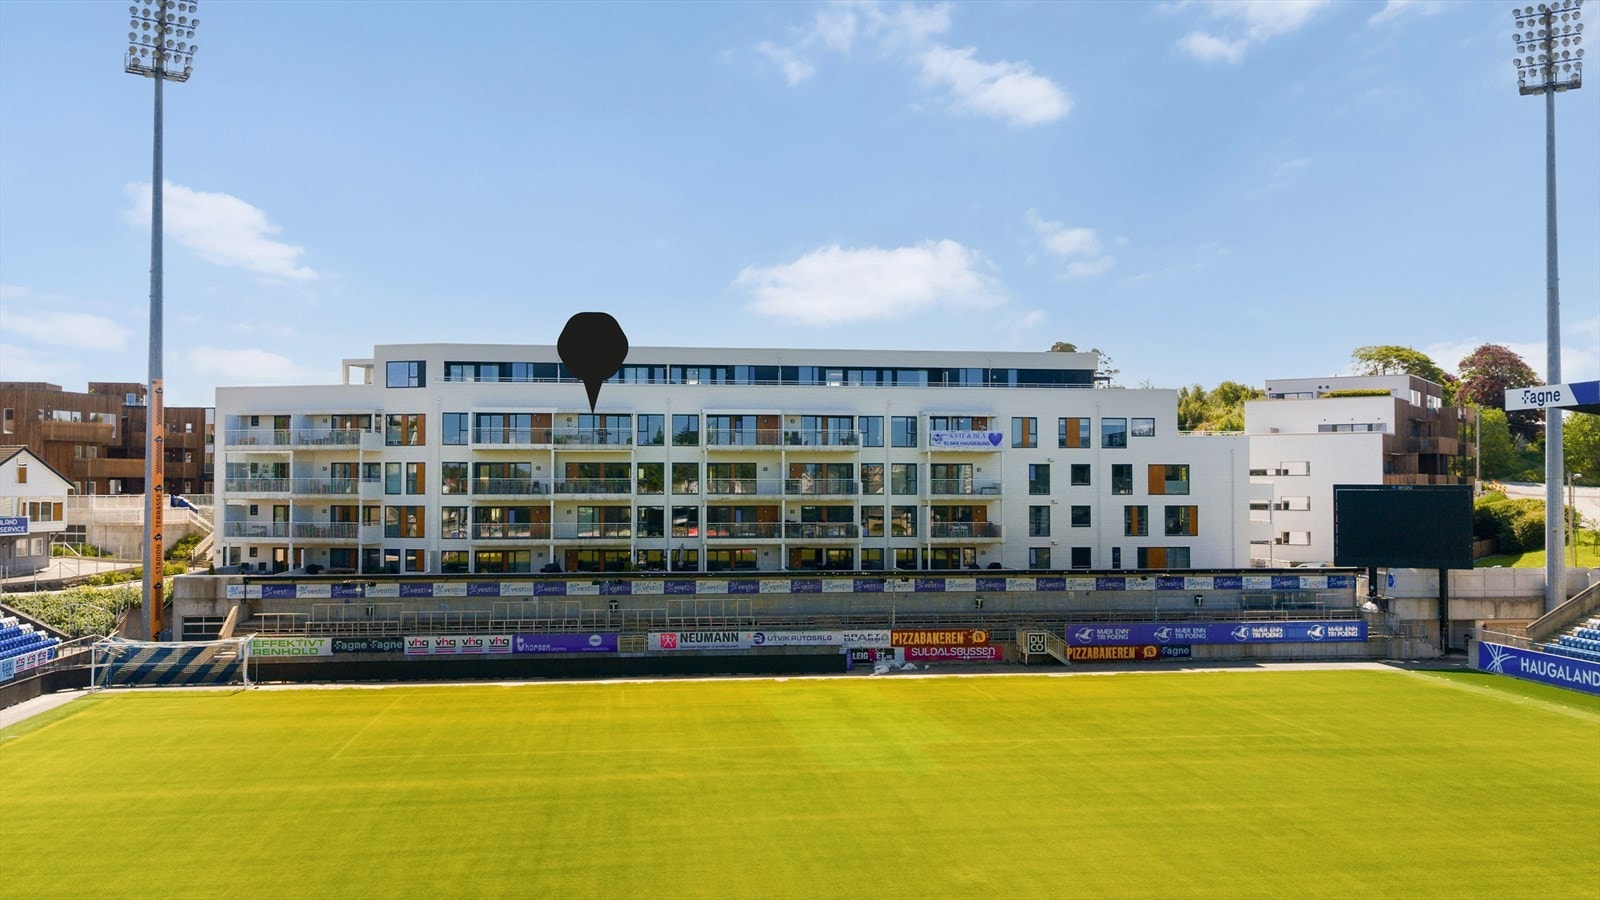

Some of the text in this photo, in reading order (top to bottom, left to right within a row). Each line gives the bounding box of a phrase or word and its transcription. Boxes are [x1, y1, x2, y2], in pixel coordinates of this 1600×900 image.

[1522, 390, 1560, 406] Fagne
[462, 638, 482, 647] vhg
[489, 637, 509, 647] vhg
[680, 633, 738, 642] NEUMANN
[892, 632, 963, 644] PIZZABAKEREN
[334, 640, 402, 649] Fagne Fagne
[408, 638, 429, 648] vhg
[435, 638, 456, 648] vhg
[1067, 646, 1135, 659] PIZZABAKEREN
[1161, 647, 1189, 655] Fagne
[1520, 657, 1600, 686] HAUGALAND
